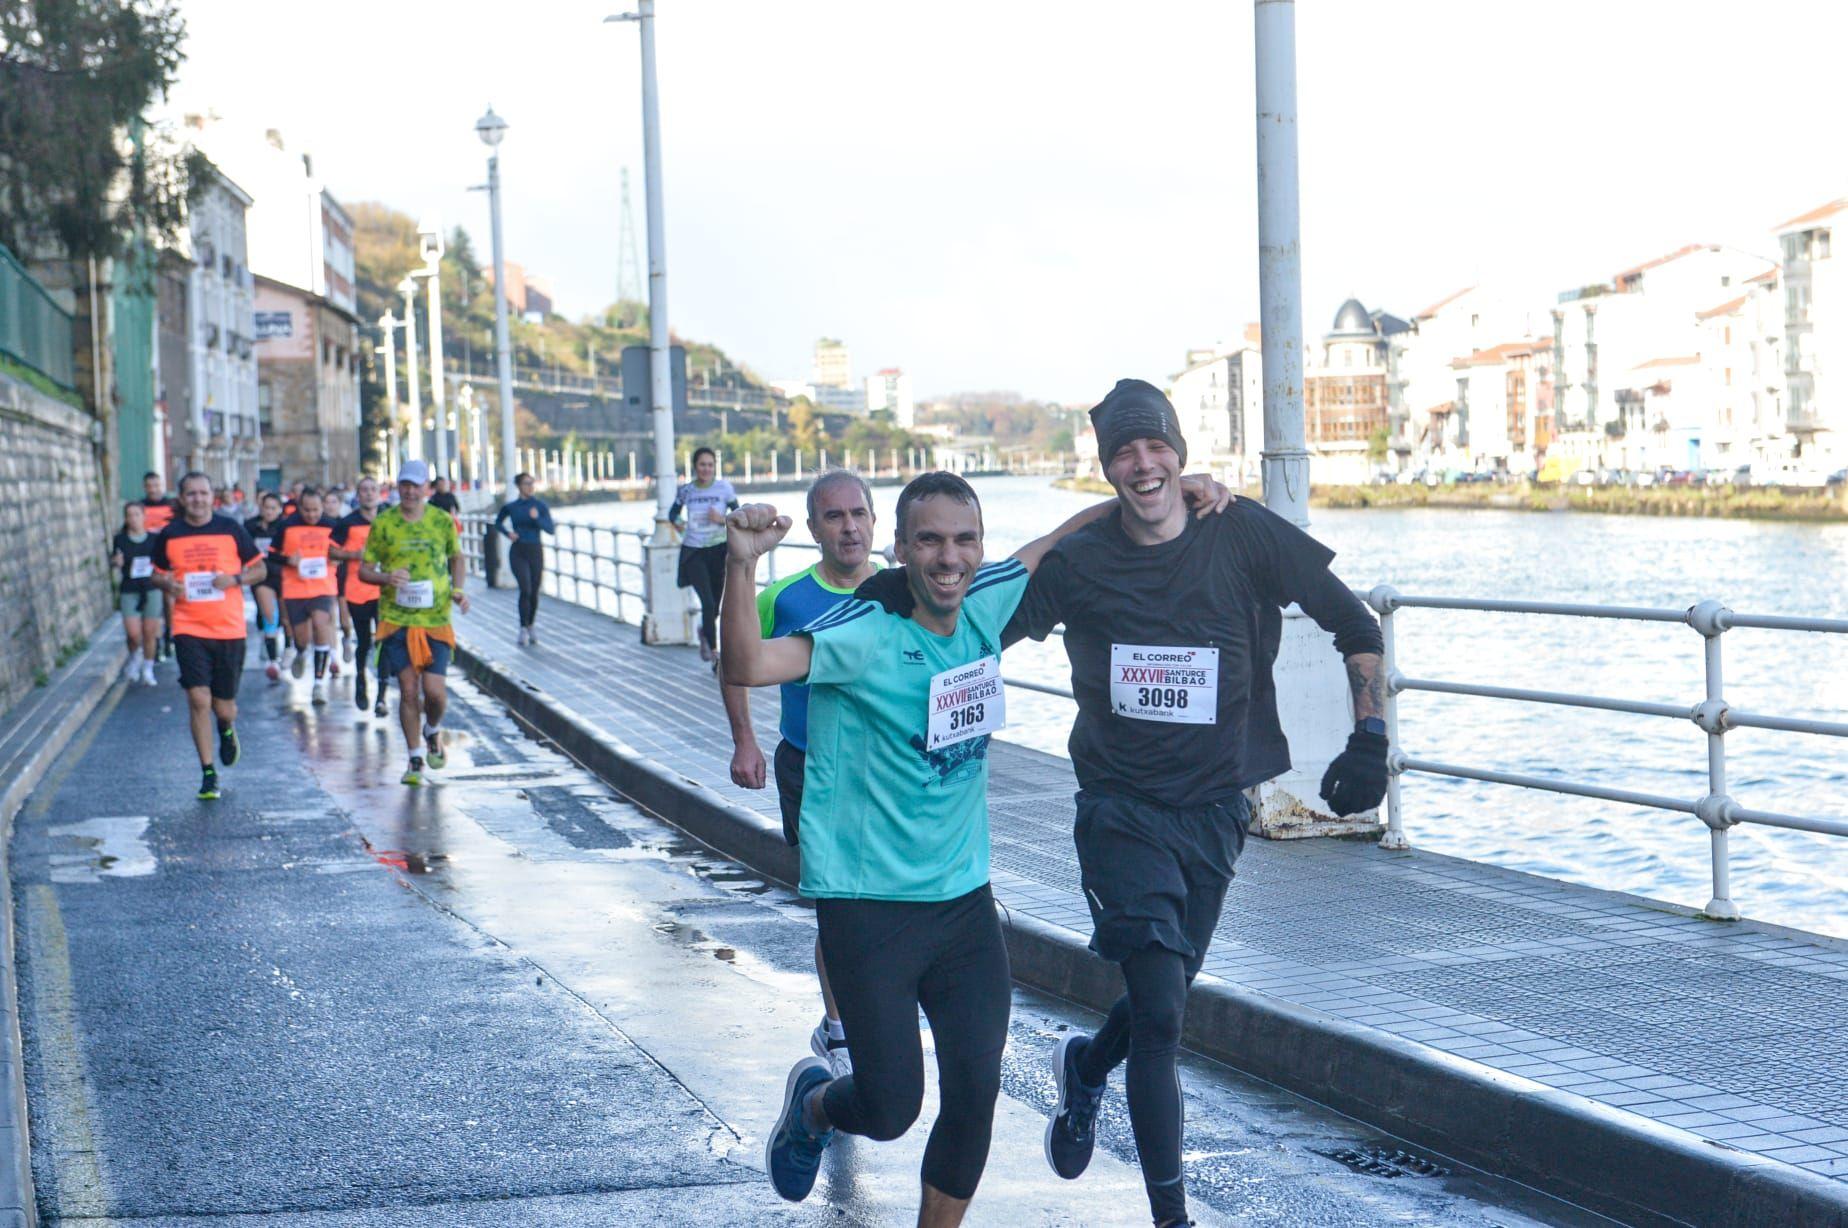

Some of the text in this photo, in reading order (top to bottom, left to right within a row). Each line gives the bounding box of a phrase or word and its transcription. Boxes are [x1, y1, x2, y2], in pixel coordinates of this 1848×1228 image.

[1133, 653, 1192, 663] EL CORREO
[943, 678, 952, 686] EL
[953, 667, 984, 683] CORREO
[1164, 669, 1206, 677] SANTURCE
[967, 679, 996, 693] SANTURCE
[1164, 676, 1206, 685] BILBAO
[967, 686, 997, 701] BILBAO
[1138, 687, 1188, 709] 3098
[950, 703, 984, 730] 3163
[1130, 706, 1174, 717] kutxabank
[942, 727, 975, 740] kutxabank
